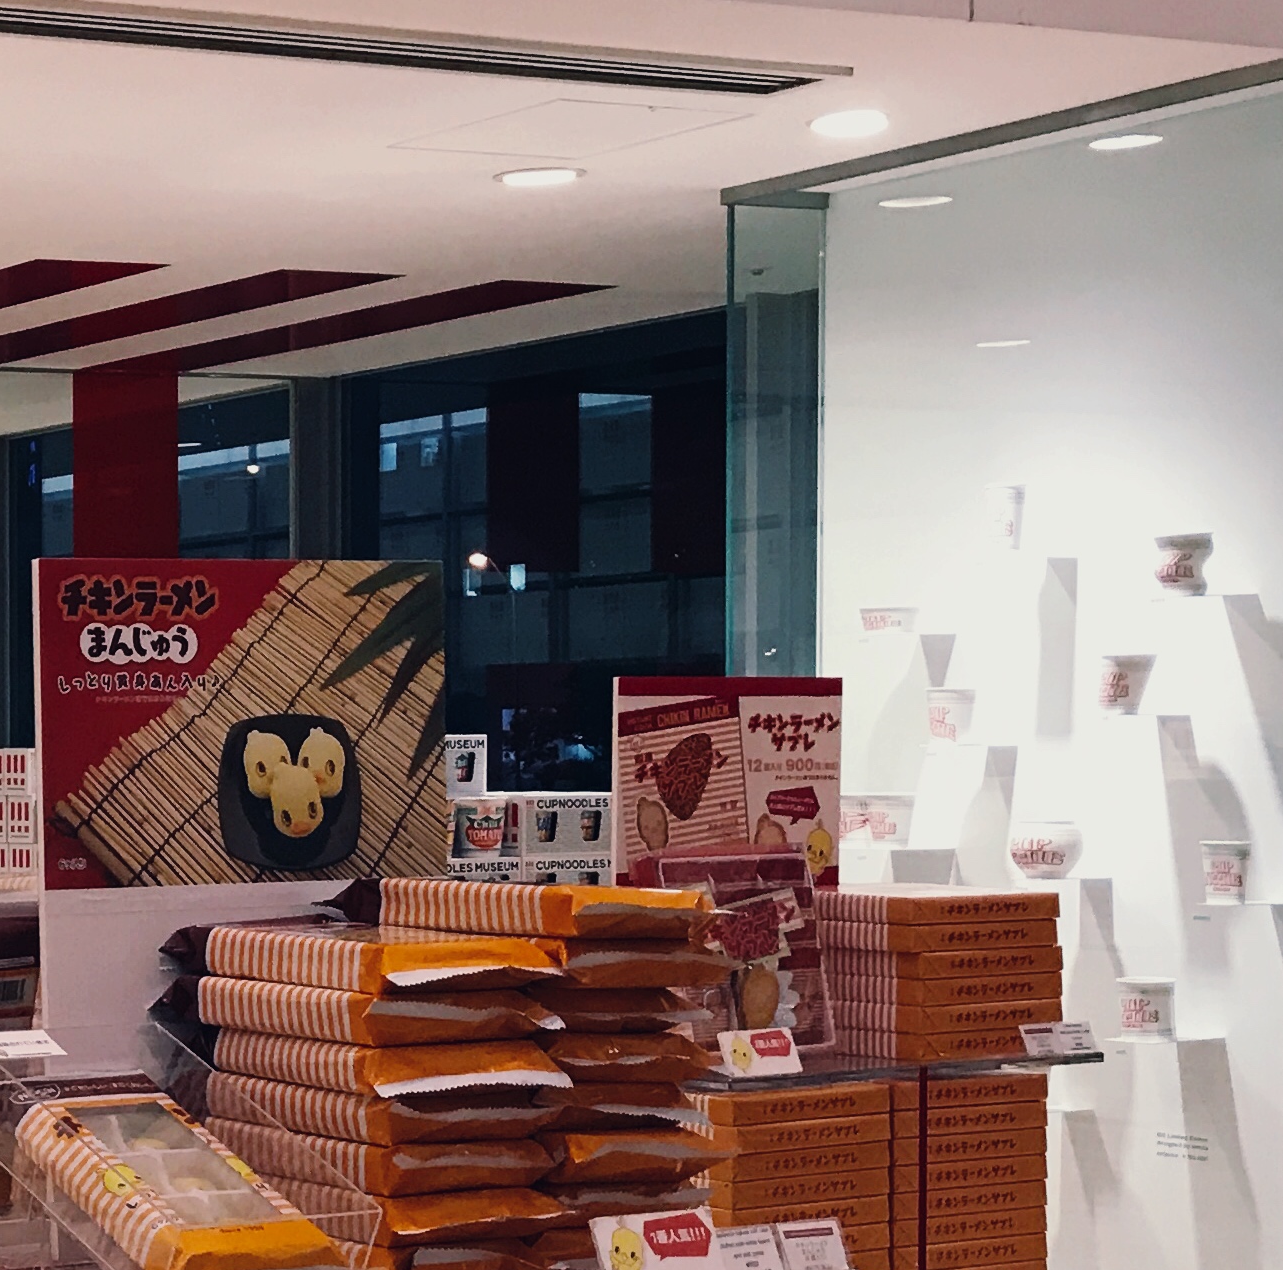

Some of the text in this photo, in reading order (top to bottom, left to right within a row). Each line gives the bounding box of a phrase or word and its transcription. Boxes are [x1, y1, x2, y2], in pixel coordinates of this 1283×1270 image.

[59, 575, 219, 621] チキンラーメン
[86, 626, 189, 658] まんじゅう
[747, 711, 841, 734] チキンラーメン
[770, 731, 816, 752] サブレ
[537, 798, 609, 809] CUPNOODLES
[475, 861, 519, 872] MUSEUM
[536, 859, 606, 870] CUPNOODLES
